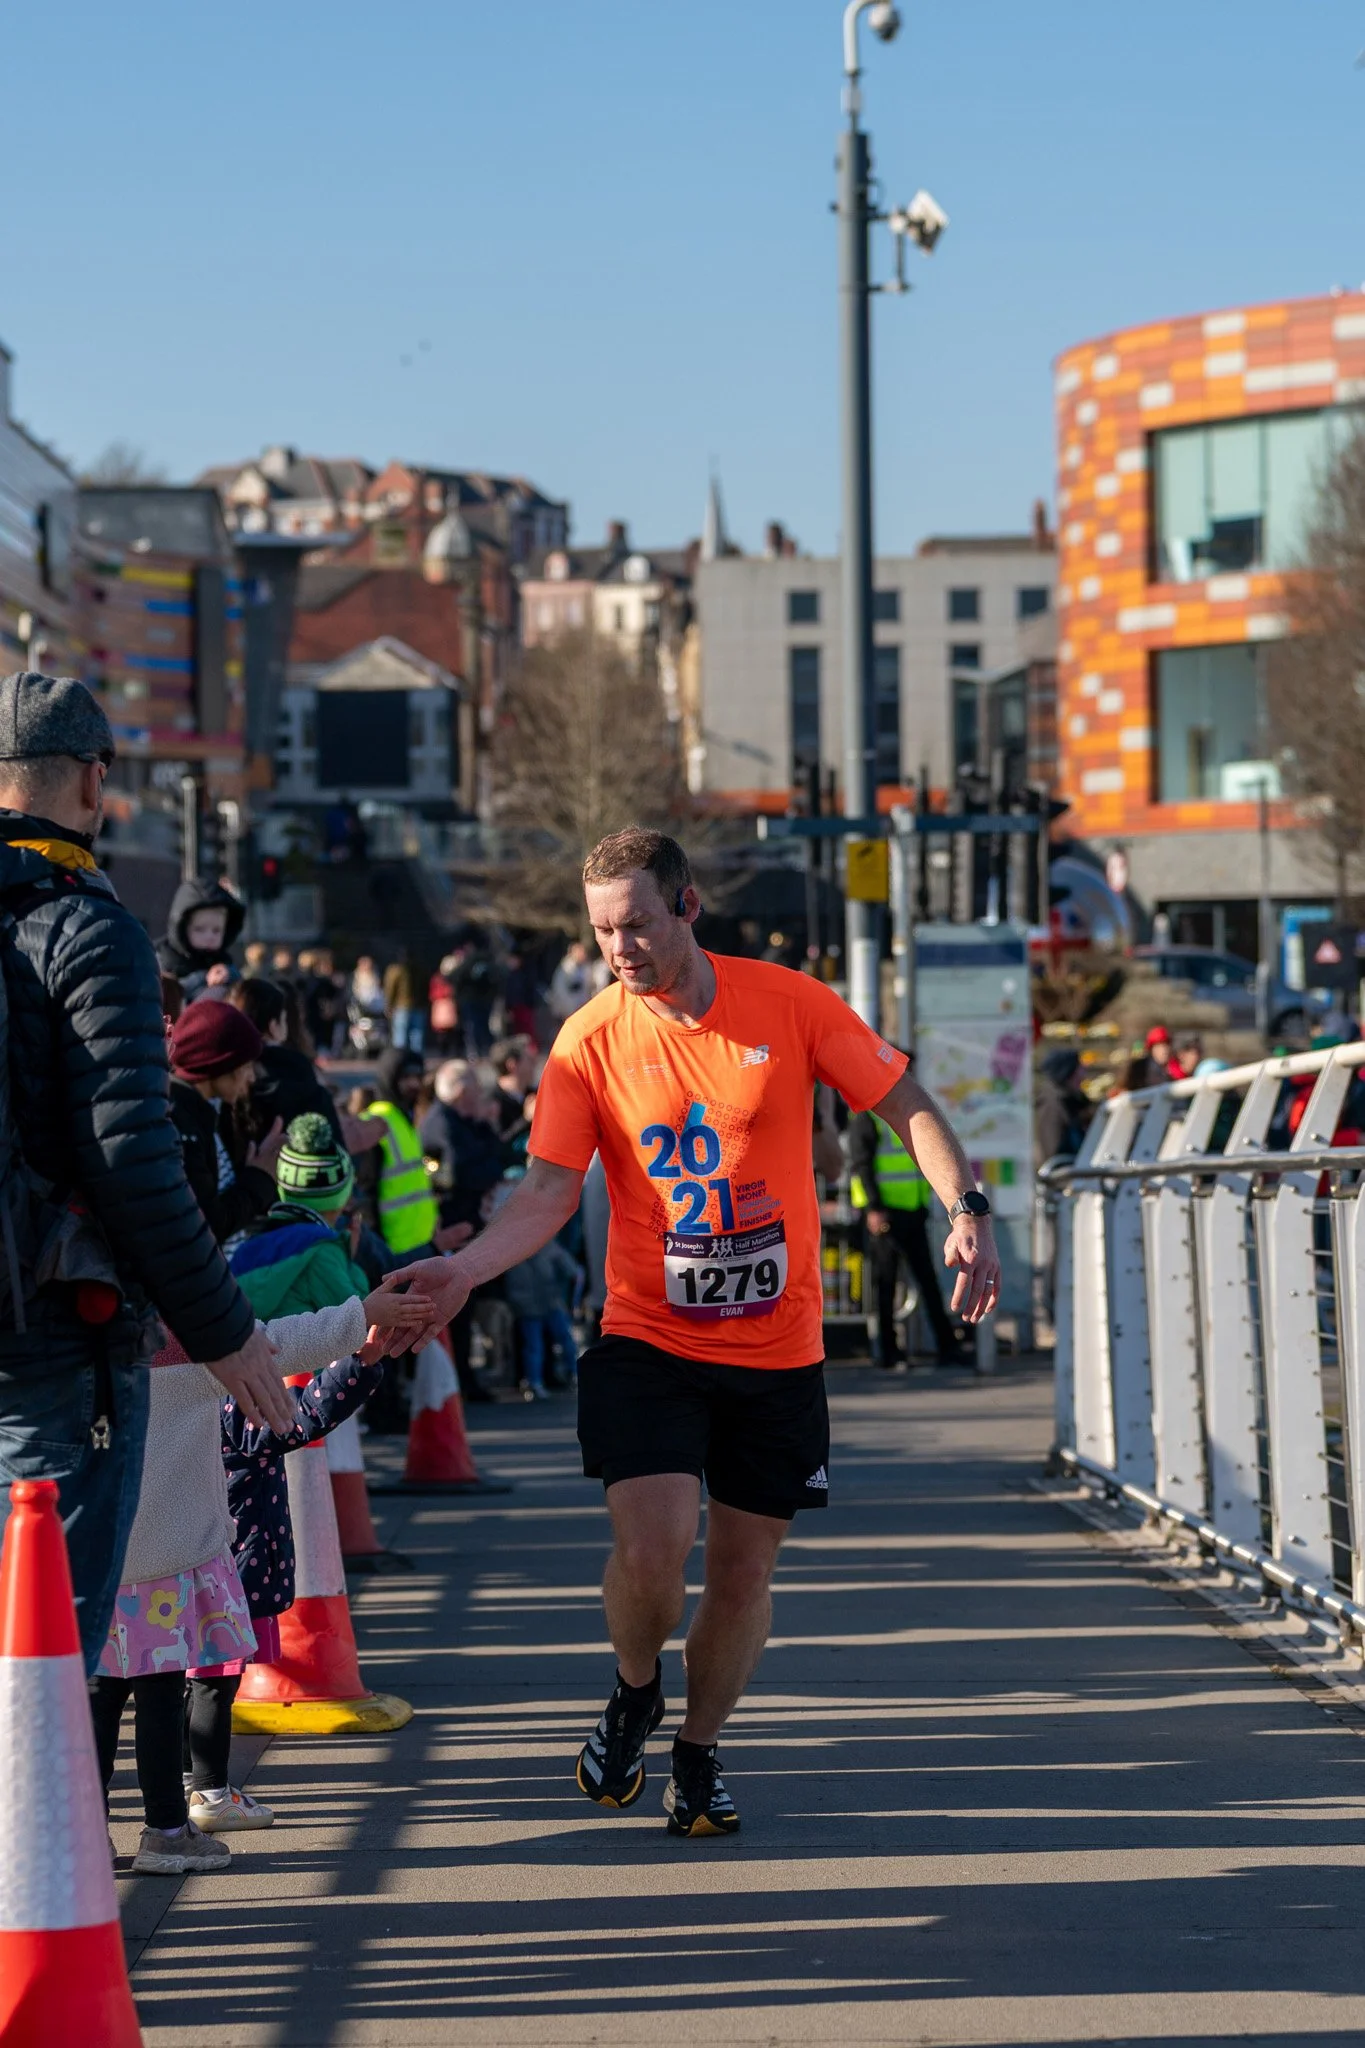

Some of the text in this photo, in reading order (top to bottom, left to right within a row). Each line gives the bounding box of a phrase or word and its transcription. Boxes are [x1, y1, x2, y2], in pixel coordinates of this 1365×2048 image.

[735, 1179, 766, 1193] VIRGIN
[736, 1187, 767, 1202] MONEY
[671, 1177, 735, 1235] 21
[739, 1211, 773, 1228] FINISHER
[674, 1241, 705, 1251] St Joseph's
[735, 1239, 750, 1250] Half
[751, 1231, 780, 1246] Marathon
[677, 1258, 779, 1305] 1279
[719, 1306, 744, 1317] EVAN
[805, 1479, 829, 1489] adidas
